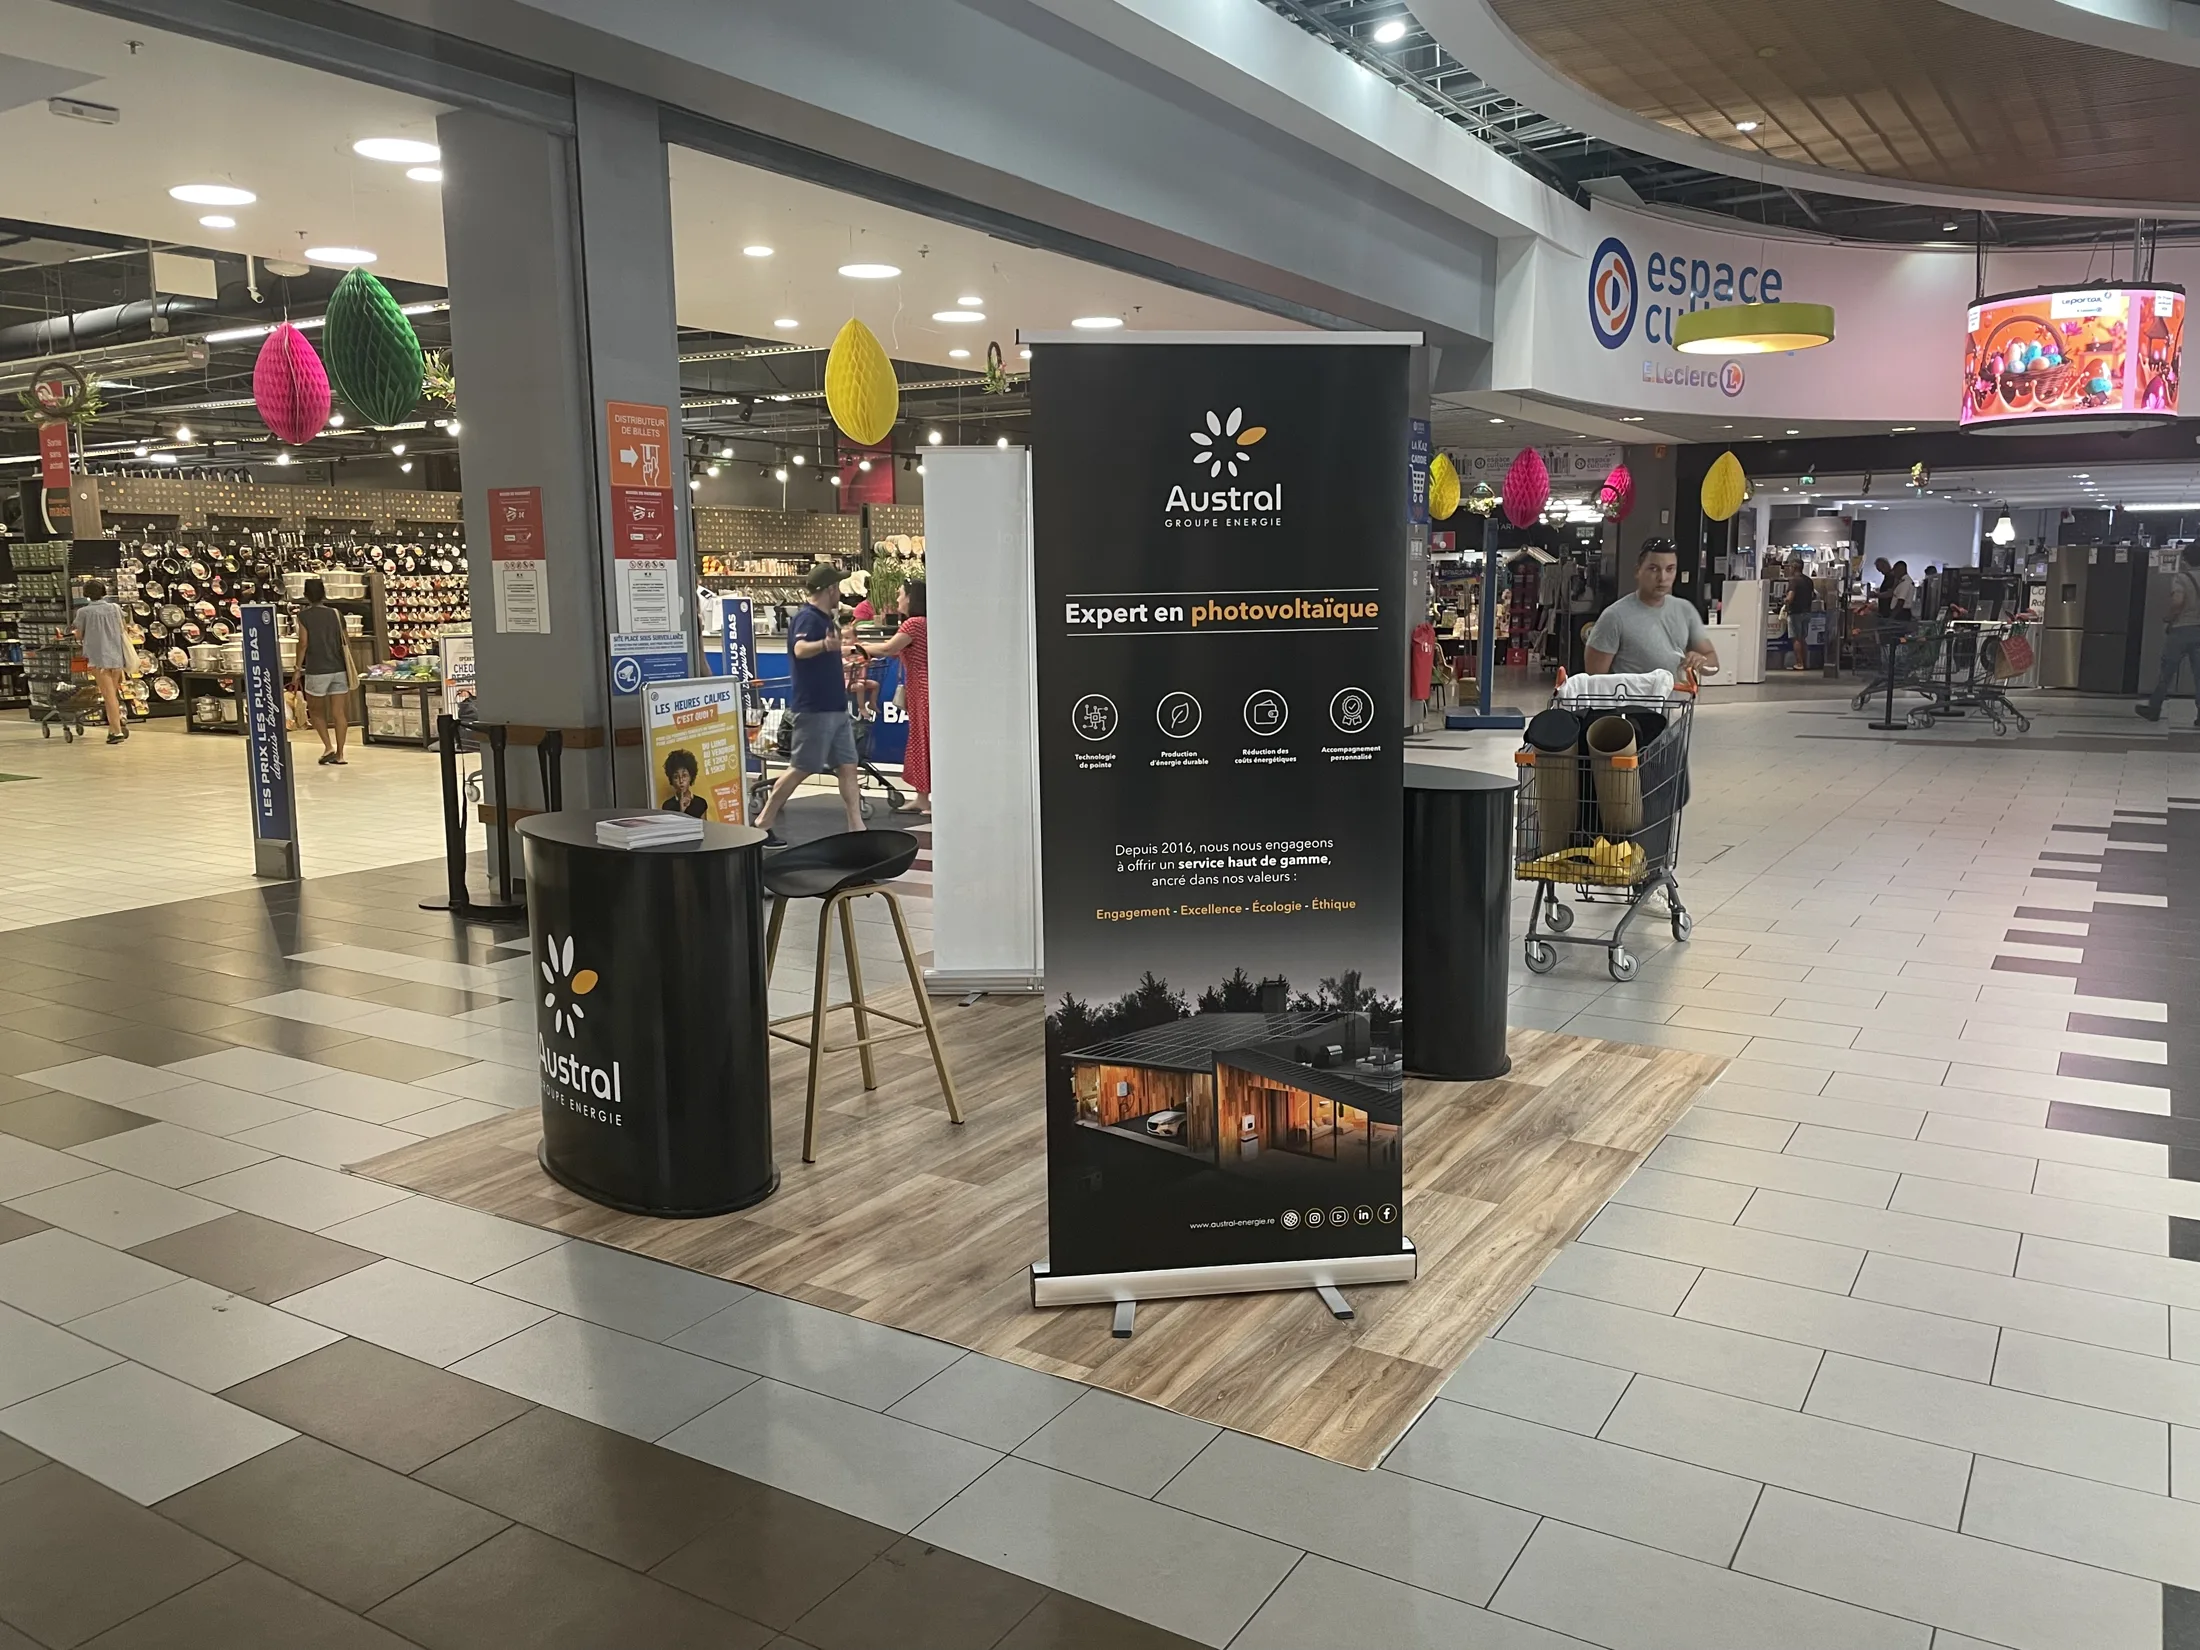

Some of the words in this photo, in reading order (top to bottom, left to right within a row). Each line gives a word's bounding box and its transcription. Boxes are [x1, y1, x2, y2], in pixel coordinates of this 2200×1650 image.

[1648, 252, 1782, 305] espace
[1642, 360, 1718, 388] E.Leclerc
[614, 414, 666, 427] DISTRIBUTEUR
[621, 426, 632, 434] DE
[632, 428, 660, 438] BILLETS
[1412, 440, 1418, 450] LA
[1164, 483, 1282, 512] Austral
[1164, 518, 1218, 528] GROUPE
[1226, 518, 1282, 527] ENERGIE
[1065, 602, 1148, 629] Expert
[1154, 604, 1184, 622] en
[1191, 598, 1378, 627] photovoltaïque
[728, 613, 737, 640] BAS
[249, 627, 260, 660] BAS
[730, 642, 740, 675] PLUS
[252, 666, 264, 708] PLUS
[262, 668, 280, 727] toujours
[655, 702, 670, 715] LES
[674, 696, 700, 712] HEURES
[883, 702, 909, 724] BA
[256, 712, 266, 742] LES
[676, 713, 694, 725] C'EST
[695, 710, 708, 721] QUOI
[268, 732, 284, 780] depuis
[1074, 753, 1116, 761] Technologie
[1253, 756, 1297, 764] énergétiques
[1321, 745, 1381, 754] Accompagnement
[1331, 754, 1372, 762] personnalisé
[260, 746, 270, 784] PRIX
[1150, 759, 1181, 767] d'énergie
[263, 790, 273, 817] LES
[1116, 844, 1159, 859] Depuis
[1161, 842, 1196, 855] 2016,
[1199, 842, 1229, 853] nous
[1232, 841, 1262, 852] nous
[1266, 838, 1334, 853] engageons
[1117, 860, 1124, 872] à
[1127, 859, 1156, 872] offrir
[1159, 861, 1175, 870] un
[1178, 856, 1224, 869] service
[1228, 856, 1257, 868] haut
[1260, 855, 1277, 867] de
[1280, 854, 1332, 868] gamme,
[1151, 874, 1186, 887] ancré
[1189, 872, 1219, 885] dans
[1222, 873, 1244, 884] nos
[1247, 871, 1290, 883] valeurs
[1096, 906, 1171, 922] Engagement
[1180, 903, 1243, 916] Excellence
[1252, 900, 1302, 914] Écologie
[1312, 897, 1356, 912] Éthique
[539, 1031, 621, 1102] Austral
[540, 1080, 565, 1106] ROUPE
[570, 1098, 622, 1126] ENERGIE
[1190, 1217, 1275, 1229] www.austral-energie.re
